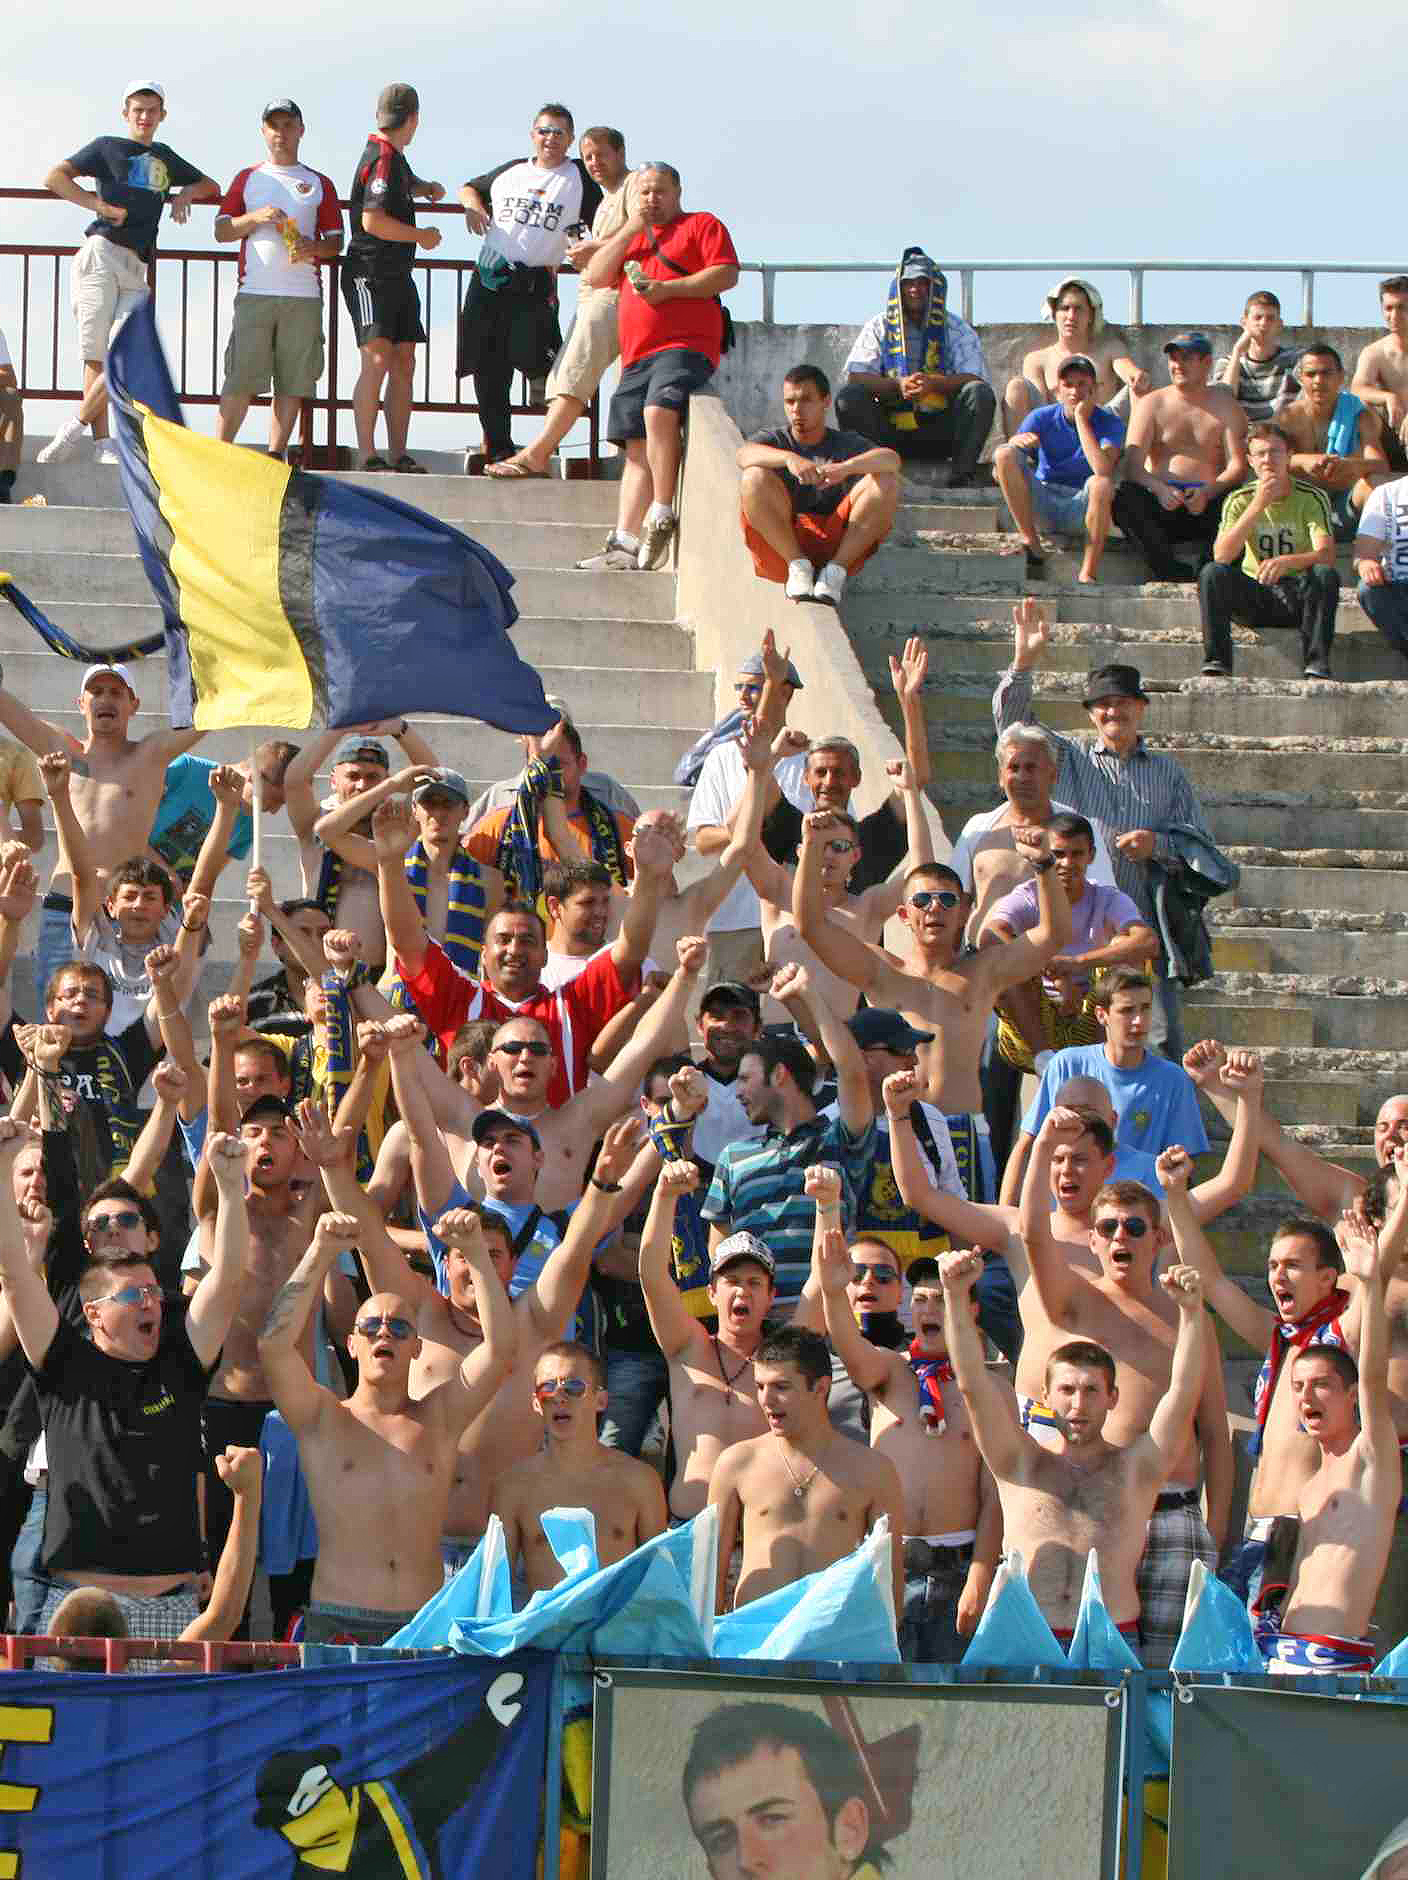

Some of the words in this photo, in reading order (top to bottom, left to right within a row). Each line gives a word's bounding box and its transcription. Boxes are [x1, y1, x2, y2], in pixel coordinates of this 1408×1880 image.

[503, 196, 564, 216] TEAM
[497, 208, 559, 232] 2010
[1259, 527, 1294, 560] 96
